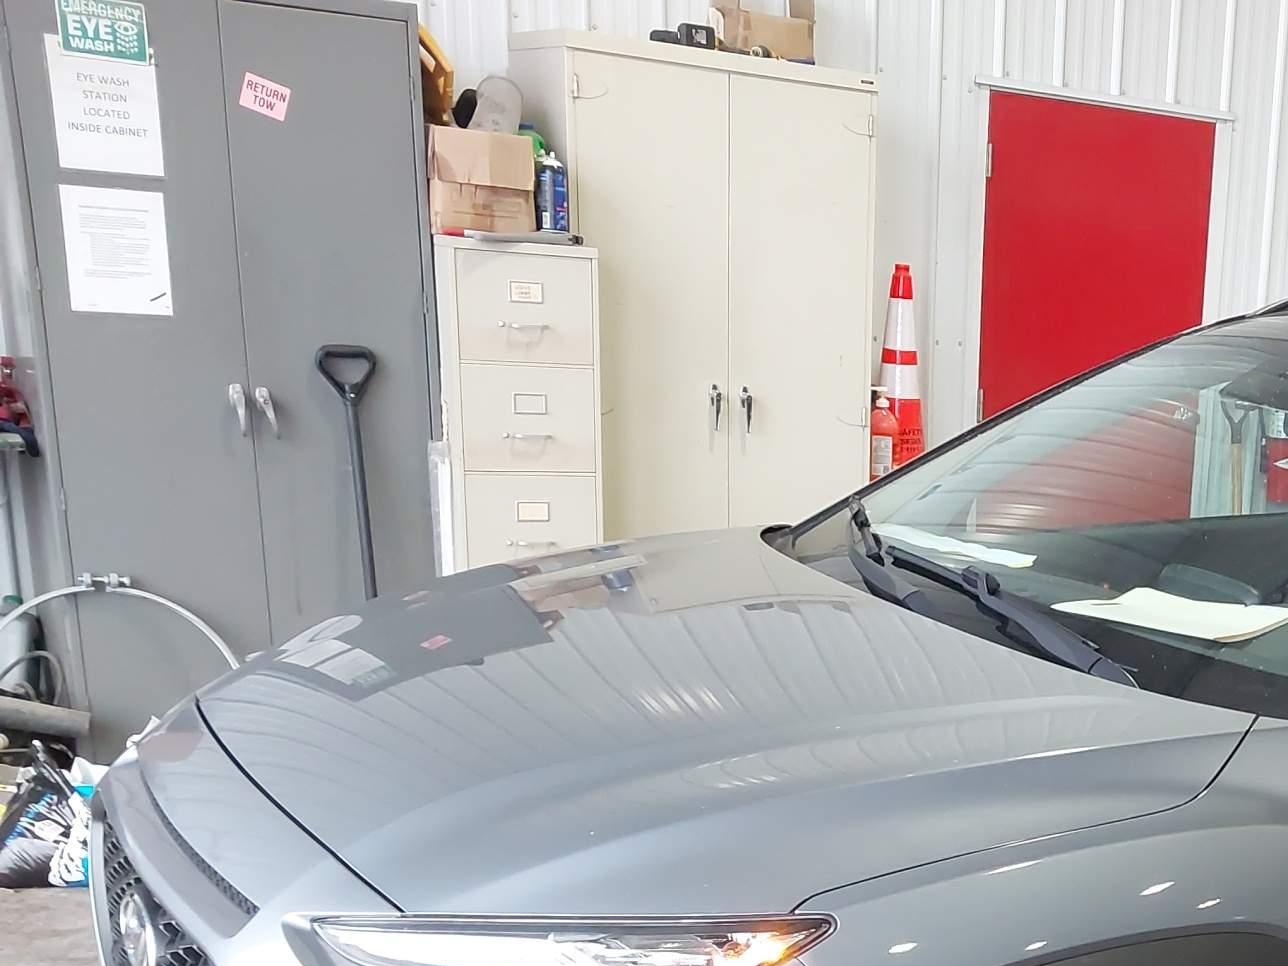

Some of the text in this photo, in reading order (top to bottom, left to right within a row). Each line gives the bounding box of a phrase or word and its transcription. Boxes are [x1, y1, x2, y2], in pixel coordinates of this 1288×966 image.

[66, 14, 113, 40] EYE
[68, 36, 115, 52] WASH
[76, 72, 130, 87] EYE WASH
[82, 89, 127, 103] STATION
[246, 79, 287, 103] RETURN
[253, 94, 276, 111] TOW
[83, 107, 130, 119] LOCATED
[67, 121, 149, 137] INSIDE CABINET
